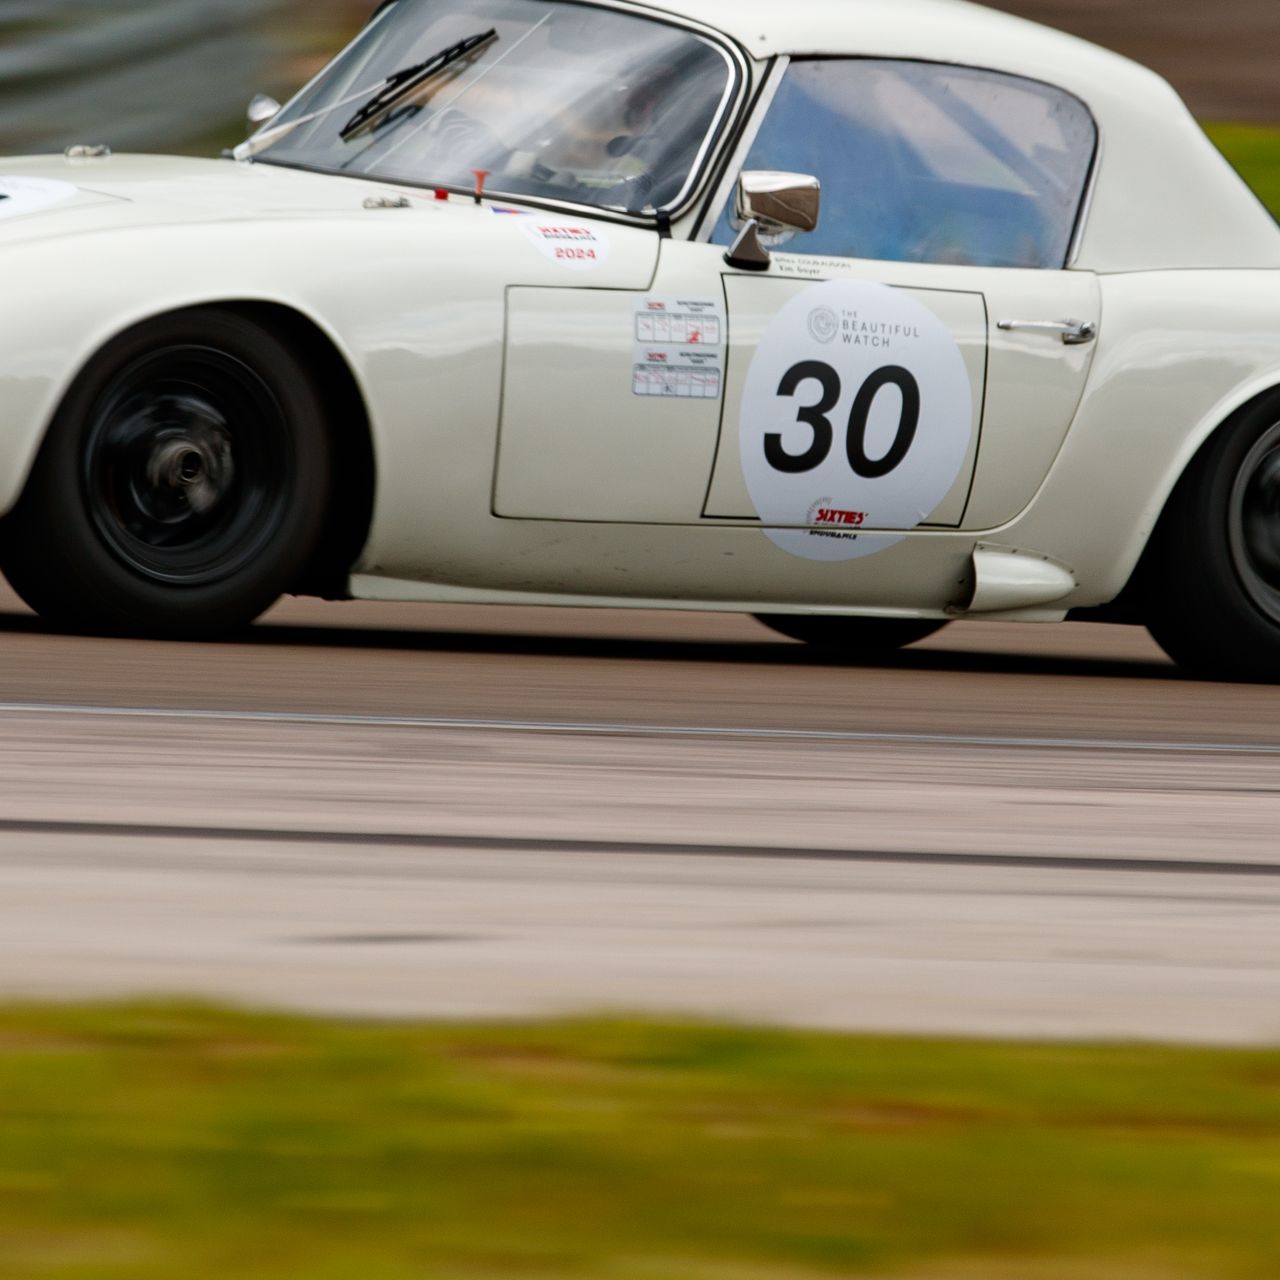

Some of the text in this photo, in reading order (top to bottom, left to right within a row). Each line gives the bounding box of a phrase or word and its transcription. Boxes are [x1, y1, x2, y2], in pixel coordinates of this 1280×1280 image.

[554, 247, 596, 260] 2024
[842, 310, 857, 318] THE
[842, 320, 920, 338] BEAUTIFUL
[842, 333, 890, 347] WATCH
[763, 359, 921, 479] 30
